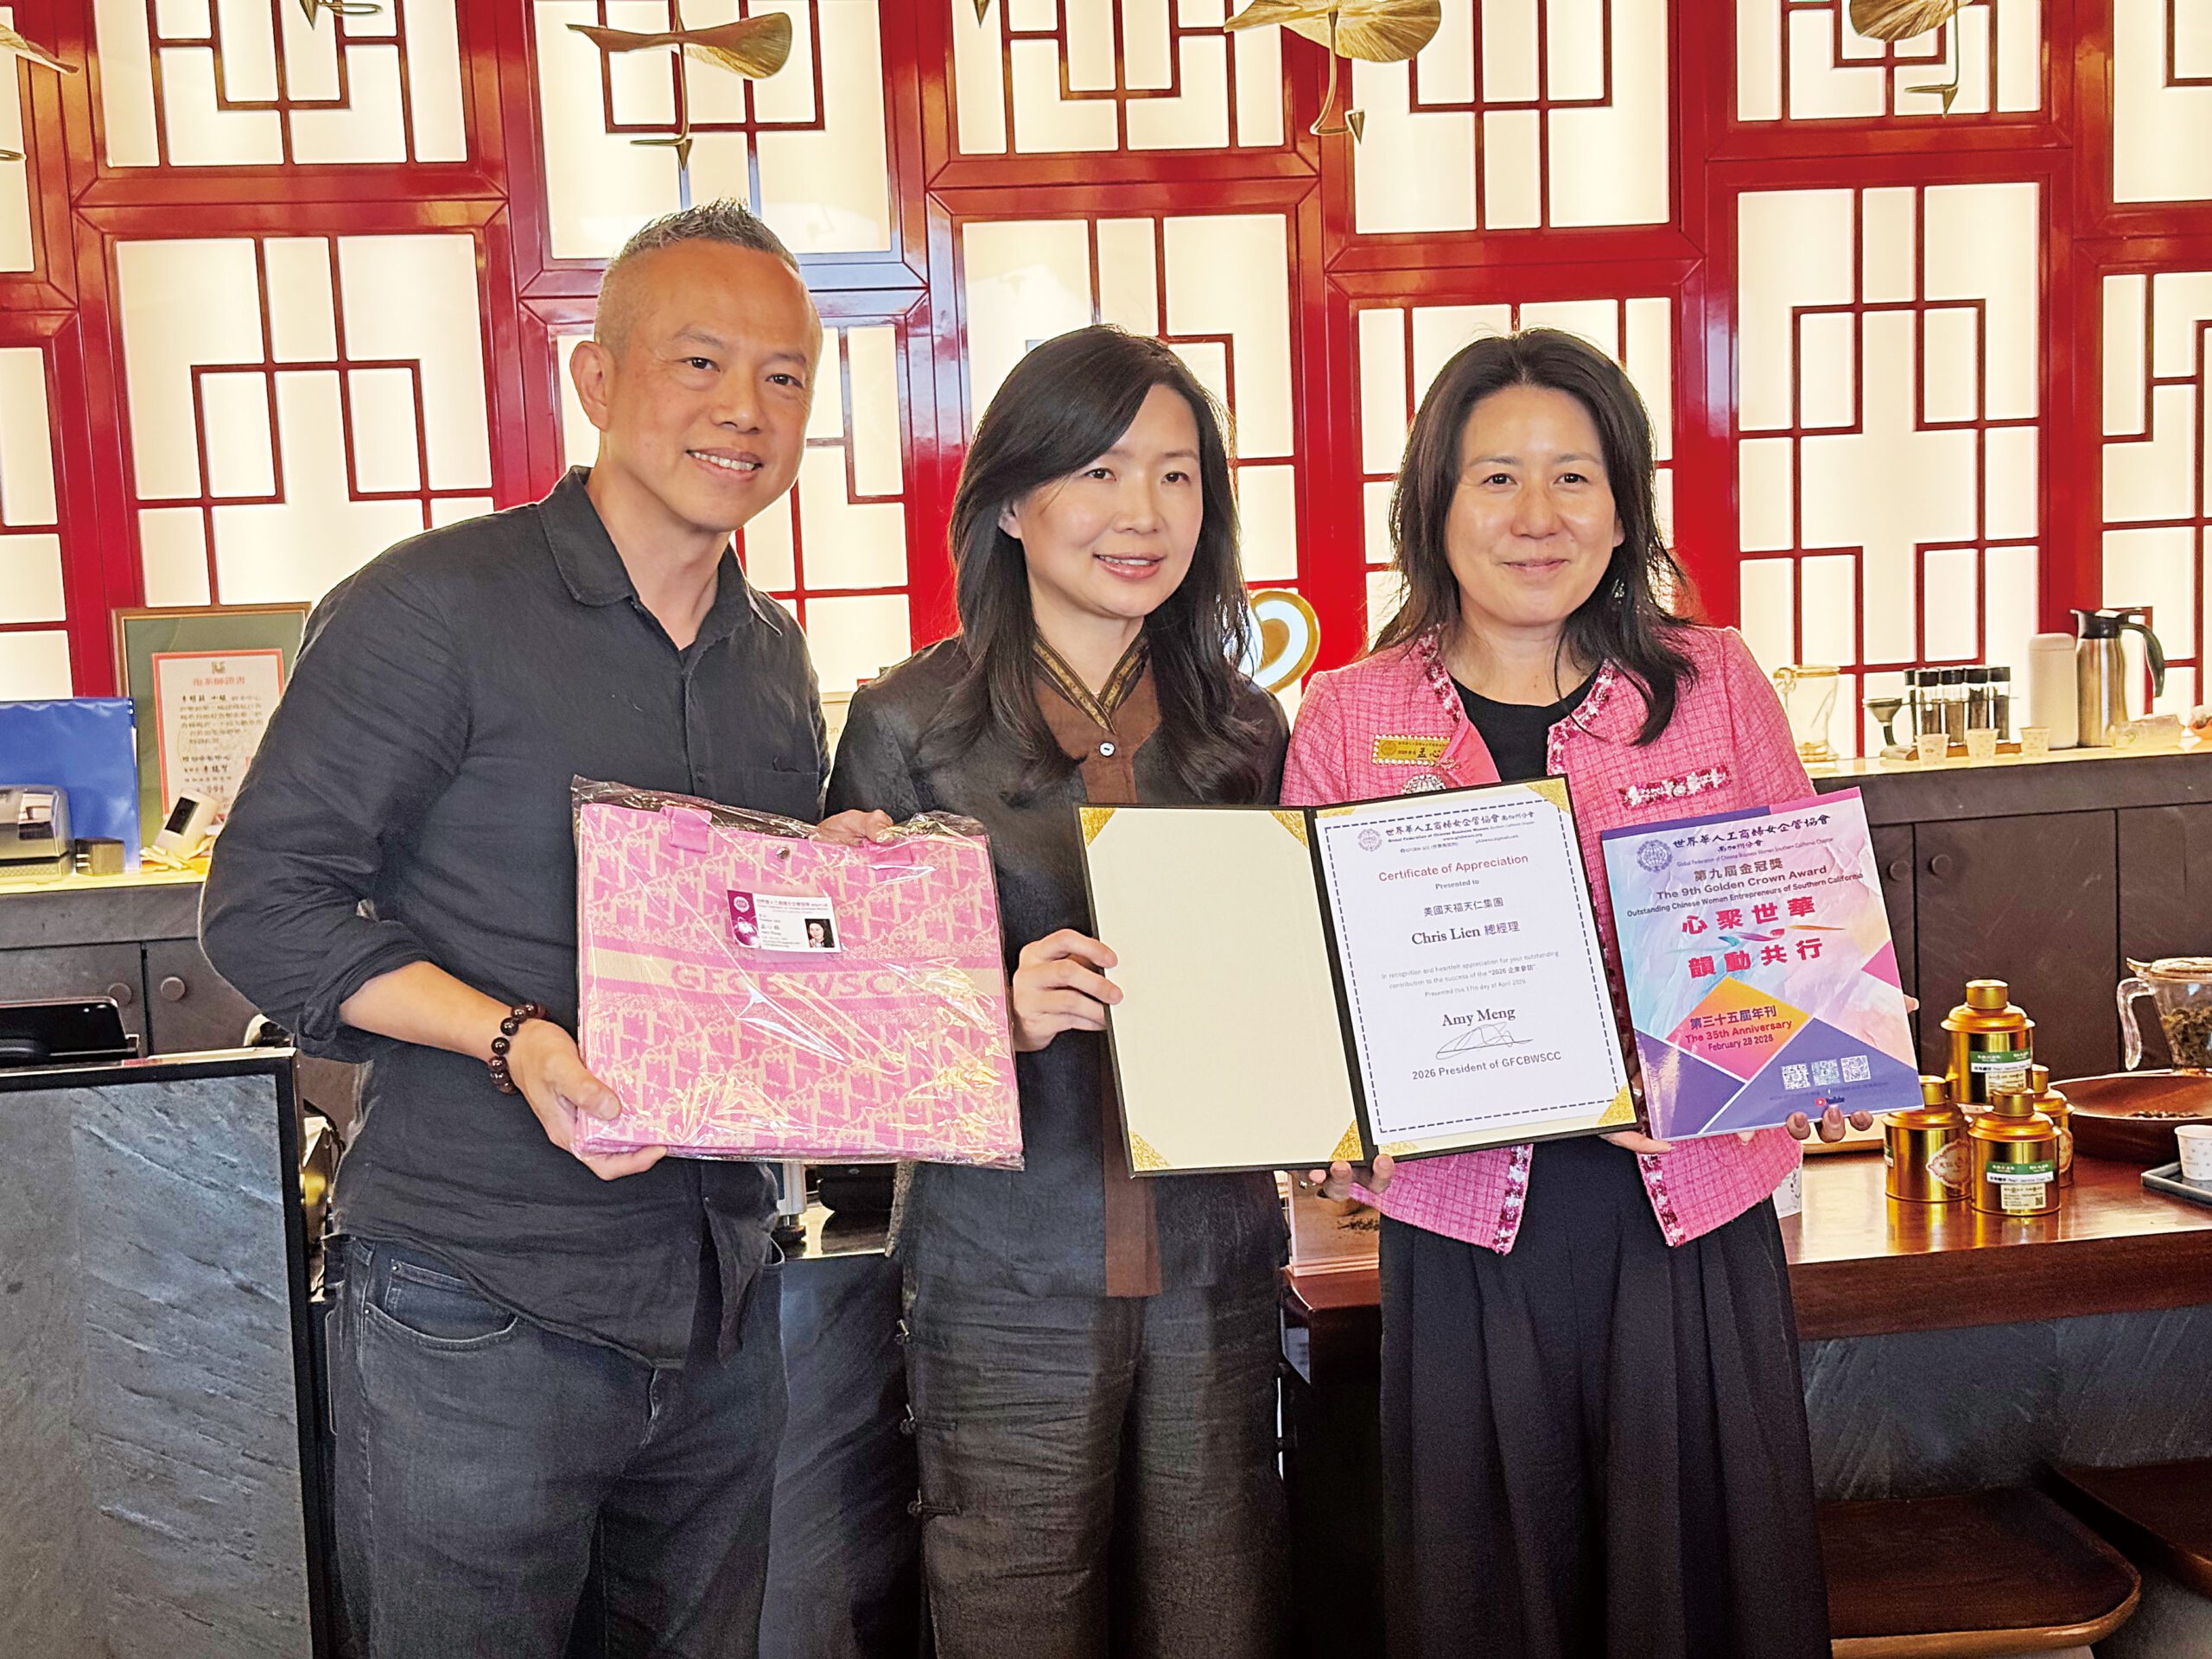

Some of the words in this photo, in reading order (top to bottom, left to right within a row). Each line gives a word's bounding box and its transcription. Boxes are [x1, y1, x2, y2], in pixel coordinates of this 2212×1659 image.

[1672, 814, 1830, 848] 世界華人工商婦女企管協會
[1378, 866, 1439, 881] Certificate
[1440, 862, 1452, 874] of
[1455, 855, 1528, 873] Appreciation
[1434, 879, 1471, 889] Presented
[1626, 905, 1670, 917] Outstanding
[1671, 900, 1700, 909] Chinese
[1700, 896, 1728, 905] Women
[1729, 887, 1782, 900] Entrepreneurs
[1792, 880, 1826, 890] Southern
[1827, 870, 1863, 884] California
[1656, 890, 1678, 899] The
[1681, 886, 1701, 896] 9th
[1703, 880, 1745, 893] Golden
[1747, 874, 1785, 886] Crown
[1789, 864, 1827, 880] Award
[1424, 897, 1503, 917] 美國天福天仁集團
[1681, 895, 1815, 934] 心聚世華
[1411, 930, 1446, 944] Chris
[1448, 926, 1480, 939] Lien
[1484, 920, 1520, 935] 總經理
[1389, 969, 1421, 978] recognition
[1461, 959, 1498, 969] appreciation
[1522, 950, 1559, 960] outstanding
[1688, 938, 1822, 978] 韻動共行
[1389, 980, 1425, 988] contribution
[1442, 1014, 1473, 1027] Amy
[1476, 1008, 1516, 1021] Meng
[1684, 1033, 1703, 1043] The
[1705, 1028, 1729, 1039] 35th
[1732, 1020, 1791, 1036] Anniversary
[1707, 1040, 1740, 1051] February
[1412, 1068, 1436, 1079] 2026
[1438, 1062, 1486, 1076] President
[1489, 1058, 1498, 1069] of
[1501, 1051, 1561, 1067] GFCBWSCC
